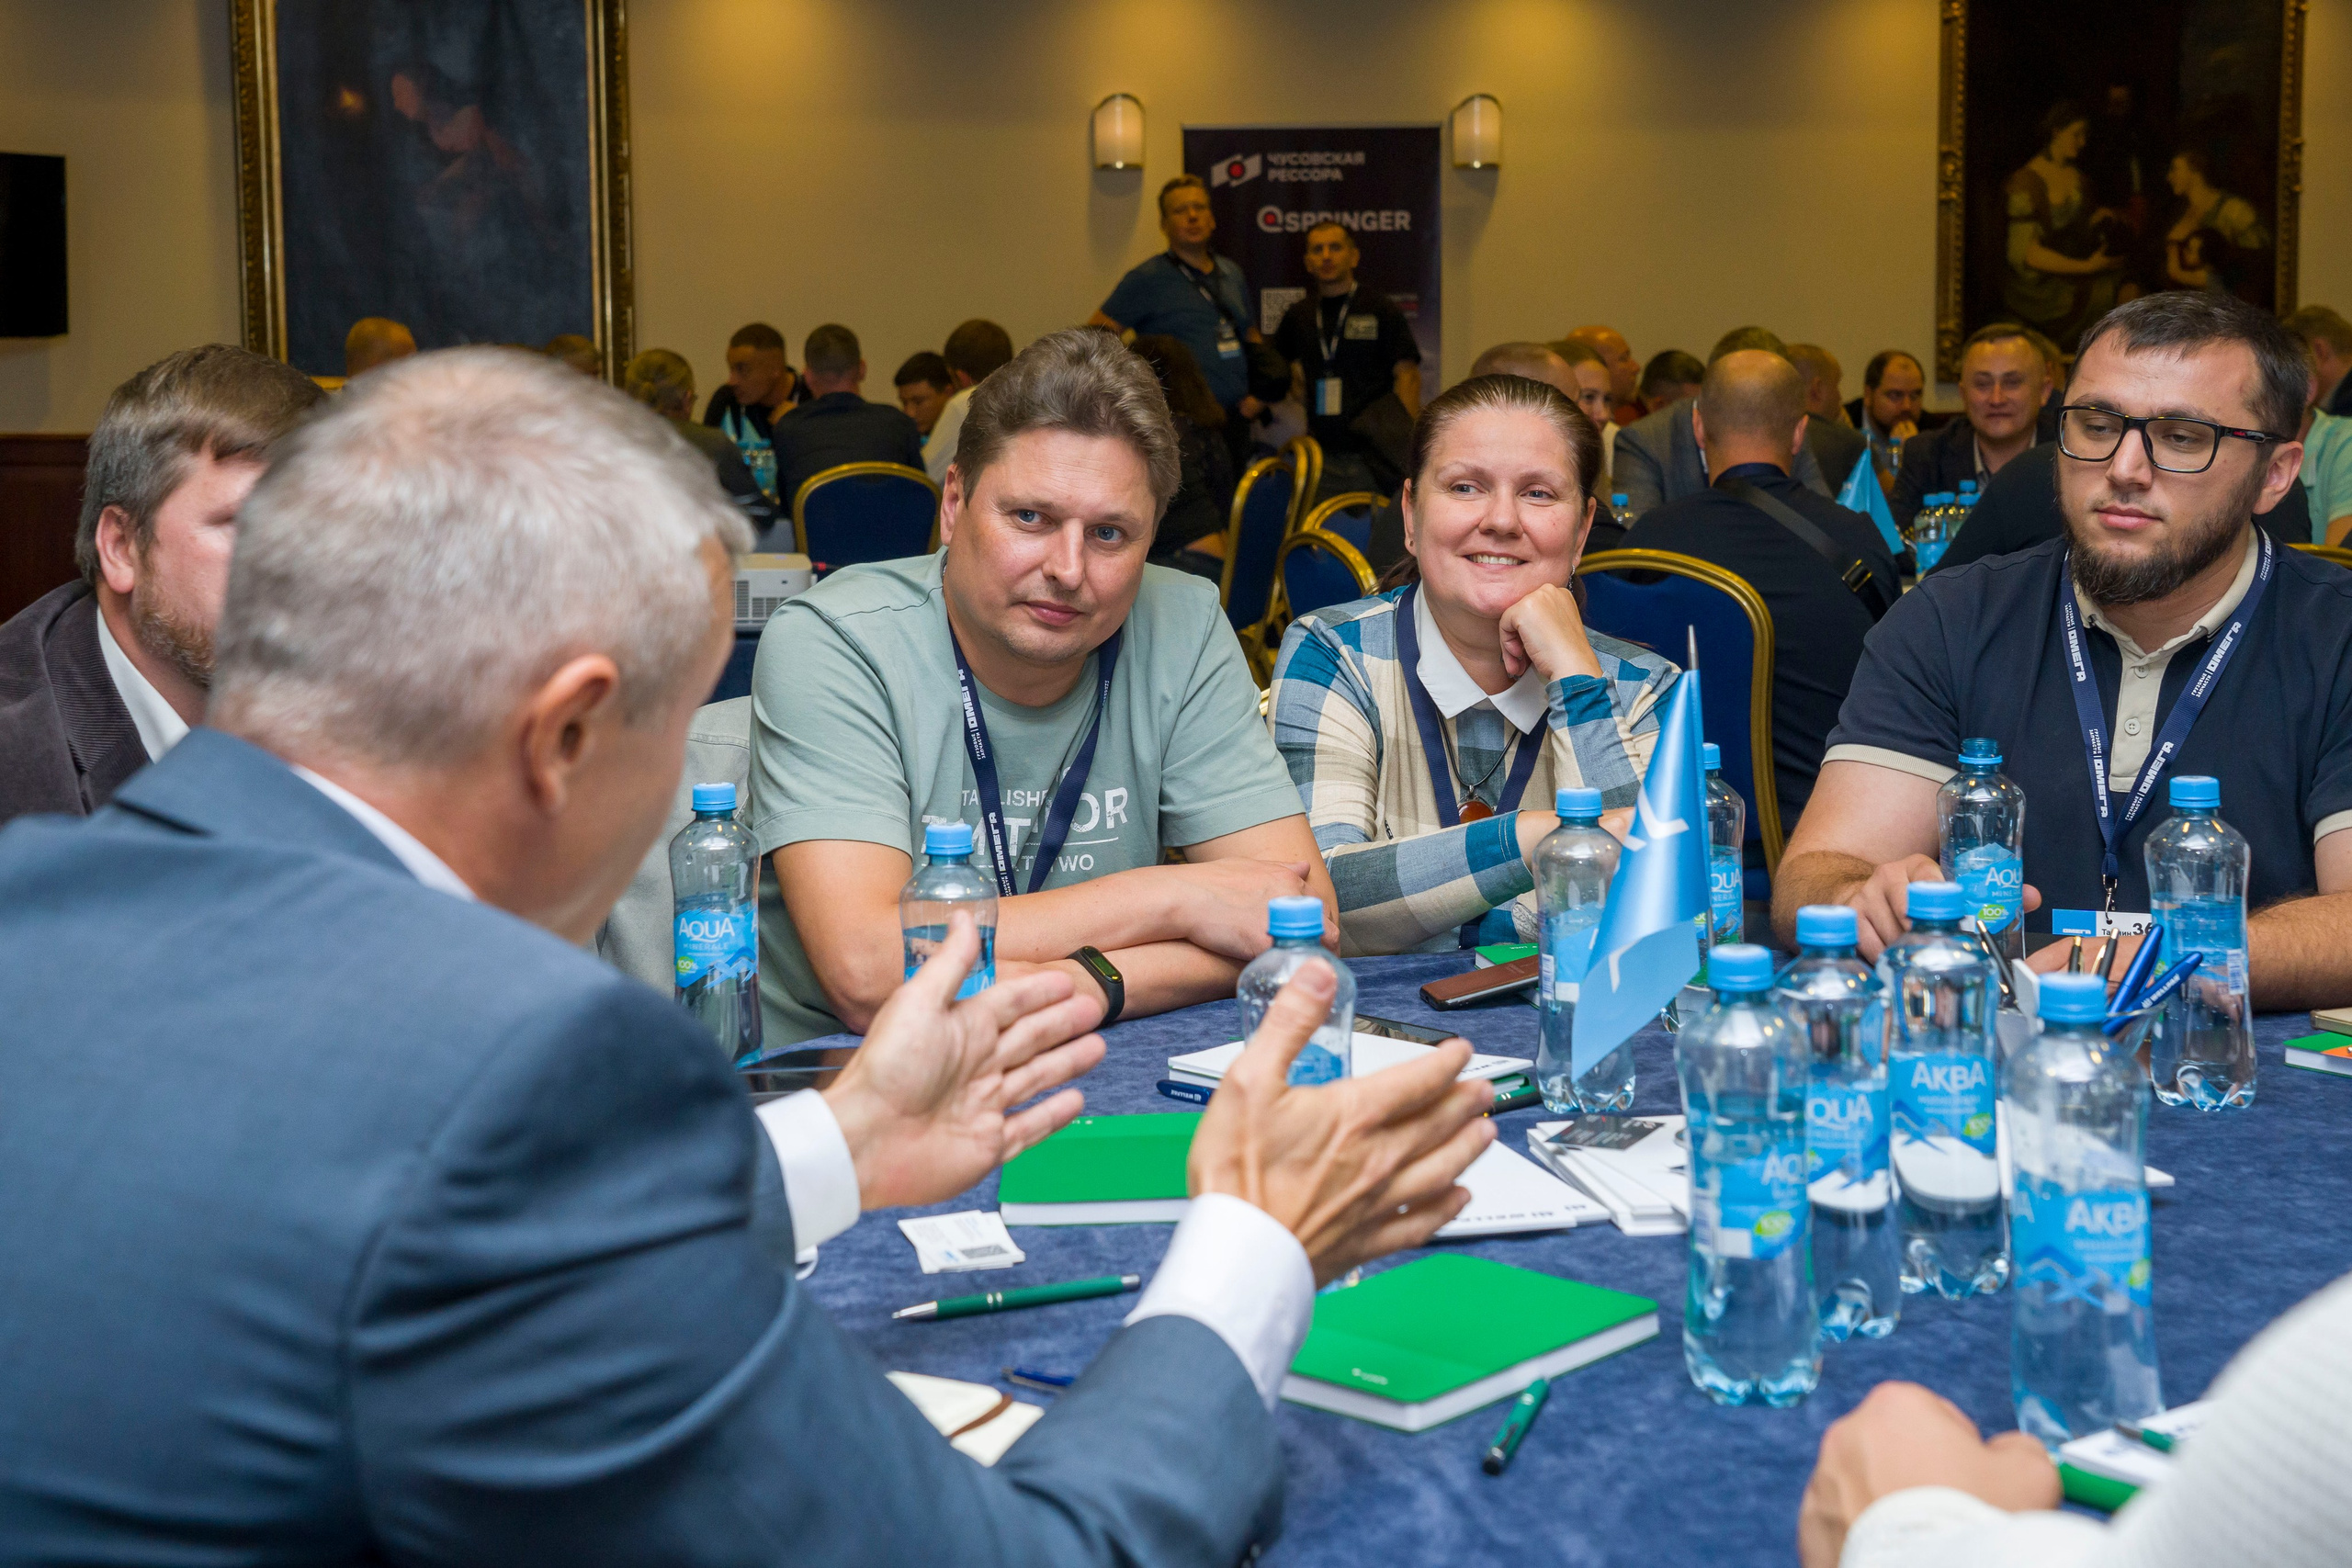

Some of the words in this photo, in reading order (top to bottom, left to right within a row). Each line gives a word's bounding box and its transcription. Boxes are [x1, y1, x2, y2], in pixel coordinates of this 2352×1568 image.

[1267, 151, 1366, 166] ЧУСОВСКАЯ
[1268, 167, 1344, 182] РЕССОРА
[2068, 629, 2086, 682] ОМЕГА
[2206, 621, 2242, 672] ОМЕГА
[976, 732, 986, 759] ЗАПЧАСТИ
[2139, 741, 2175, 795] ОМЕГА
[2093, 759, 2109, 818] ОМЕГА
[989, 812, 1006, 872] ОМЕГА
[1711, 867, 1742, 894] QUA
[1985, 866, 2021, 888] AQU
[679, 918, 736, 943] AQUA
[1911, 1061, 1987, 1095] АКВА
